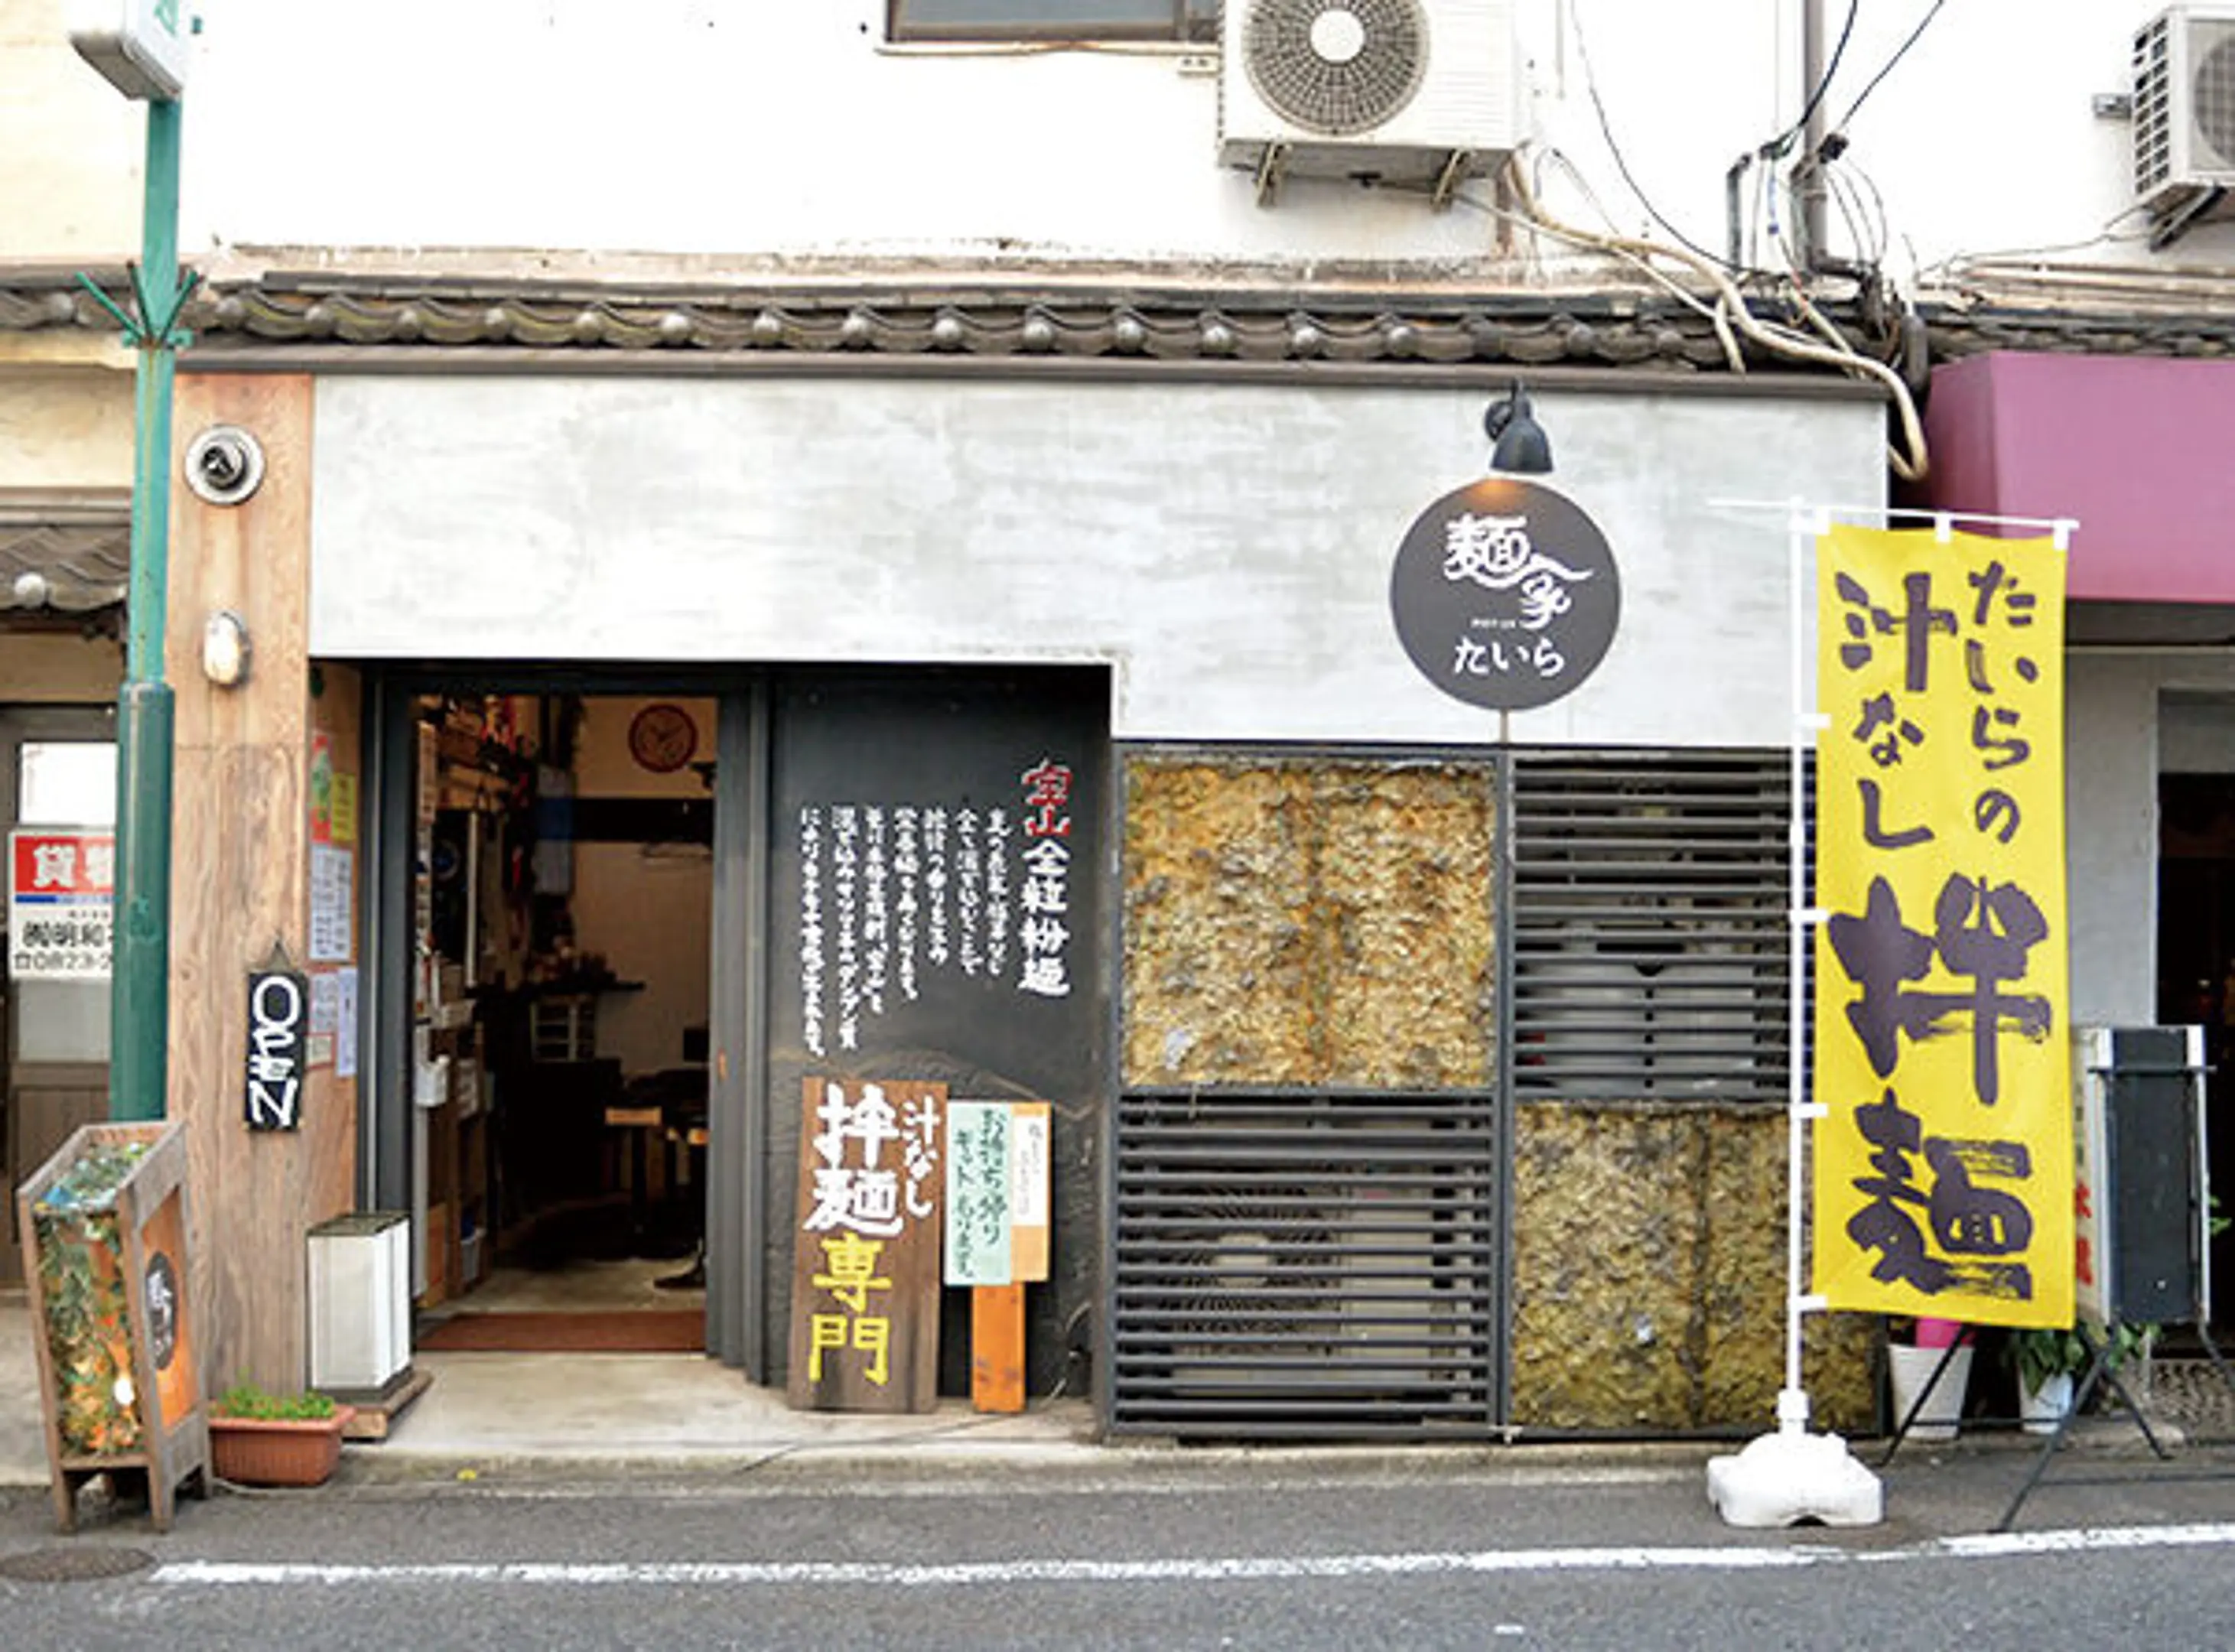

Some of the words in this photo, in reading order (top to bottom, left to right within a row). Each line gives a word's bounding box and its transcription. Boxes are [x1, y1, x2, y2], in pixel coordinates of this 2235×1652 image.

[1455, 636, 1565, 677] たいら
[1835, 571, 1958, 849] 汁なし
[1966, 561, 2038, 844] たいらの
[903, 1094, 942, 1218] 汁なし
